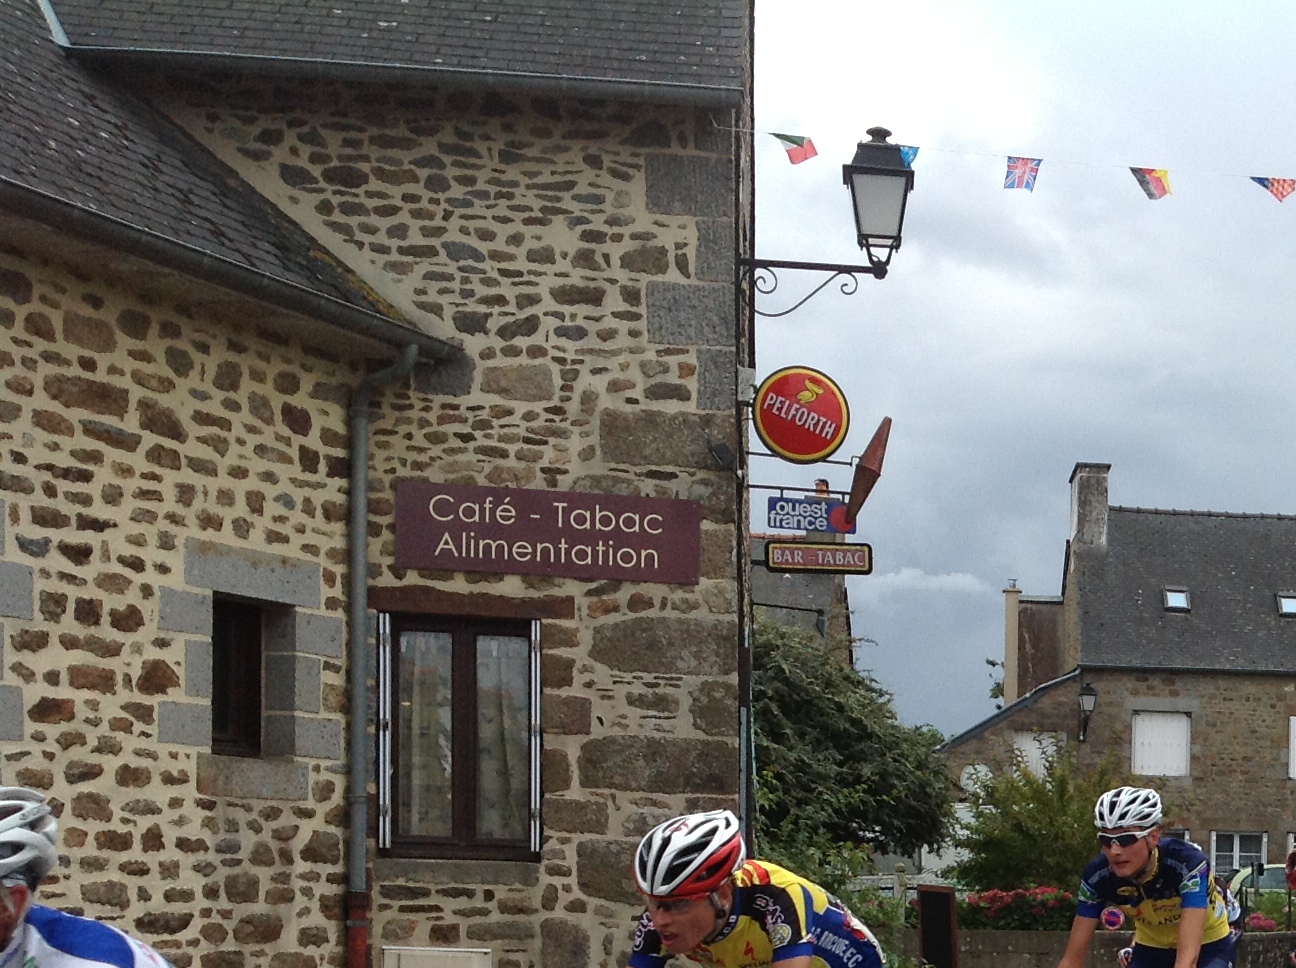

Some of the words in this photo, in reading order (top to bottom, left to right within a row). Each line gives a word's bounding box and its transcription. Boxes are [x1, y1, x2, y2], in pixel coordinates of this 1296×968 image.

[763, 392, 837, 440] PELFORTH
[429, 494, 517, 525] Café
[553, 502, 664, 534] Tabac
[769, 510, 828, 530] france
[775, 501, 828, 518] ouest
[434, 531, 660, 569] Alimentation
[773, 549, 803, 563] BAR
[816, 550, 865, 566] TABAC
